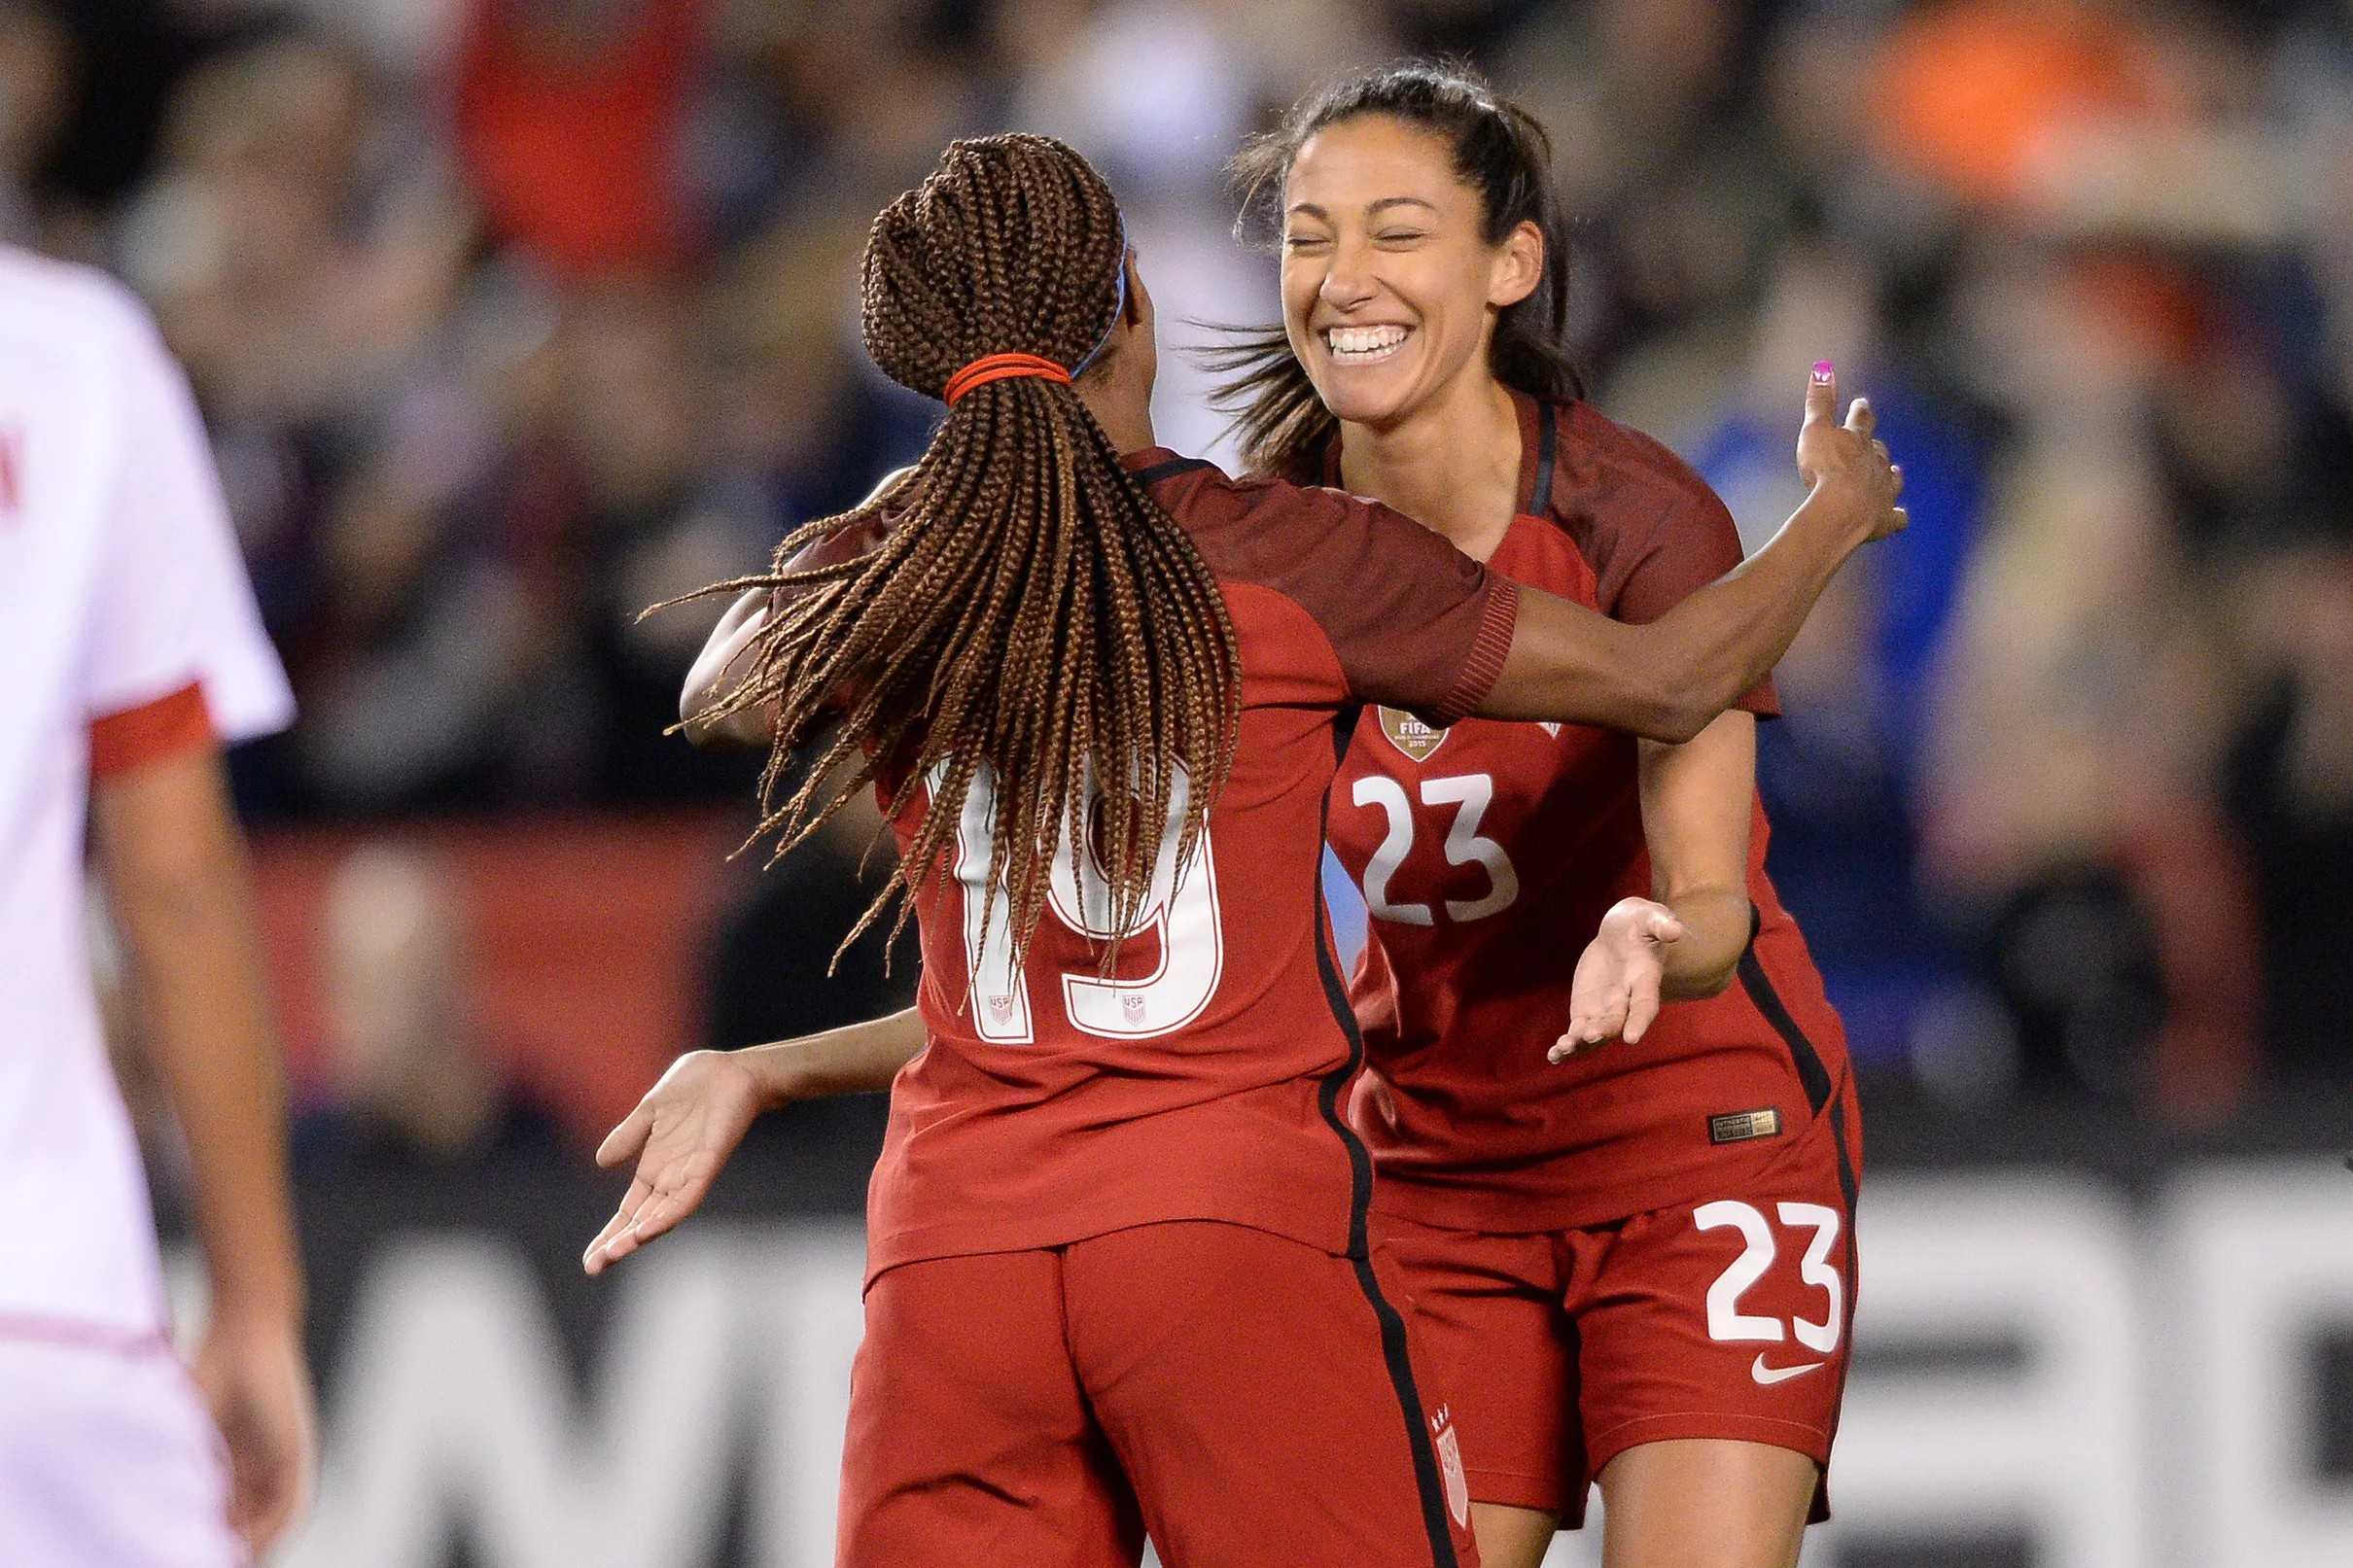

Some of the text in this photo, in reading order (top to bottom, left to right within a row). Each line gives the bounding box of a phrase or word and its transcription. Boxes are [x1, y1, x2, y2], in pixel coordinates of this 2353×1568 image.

[1400, 723, 1431, 734] FIFA
[925, 747, 1223, 1043] 19
[1352, 773, 1518, 925] 23
[1124, 996, 1142, 1008] USA
[1693, 1200, 1842, 1352] 23
